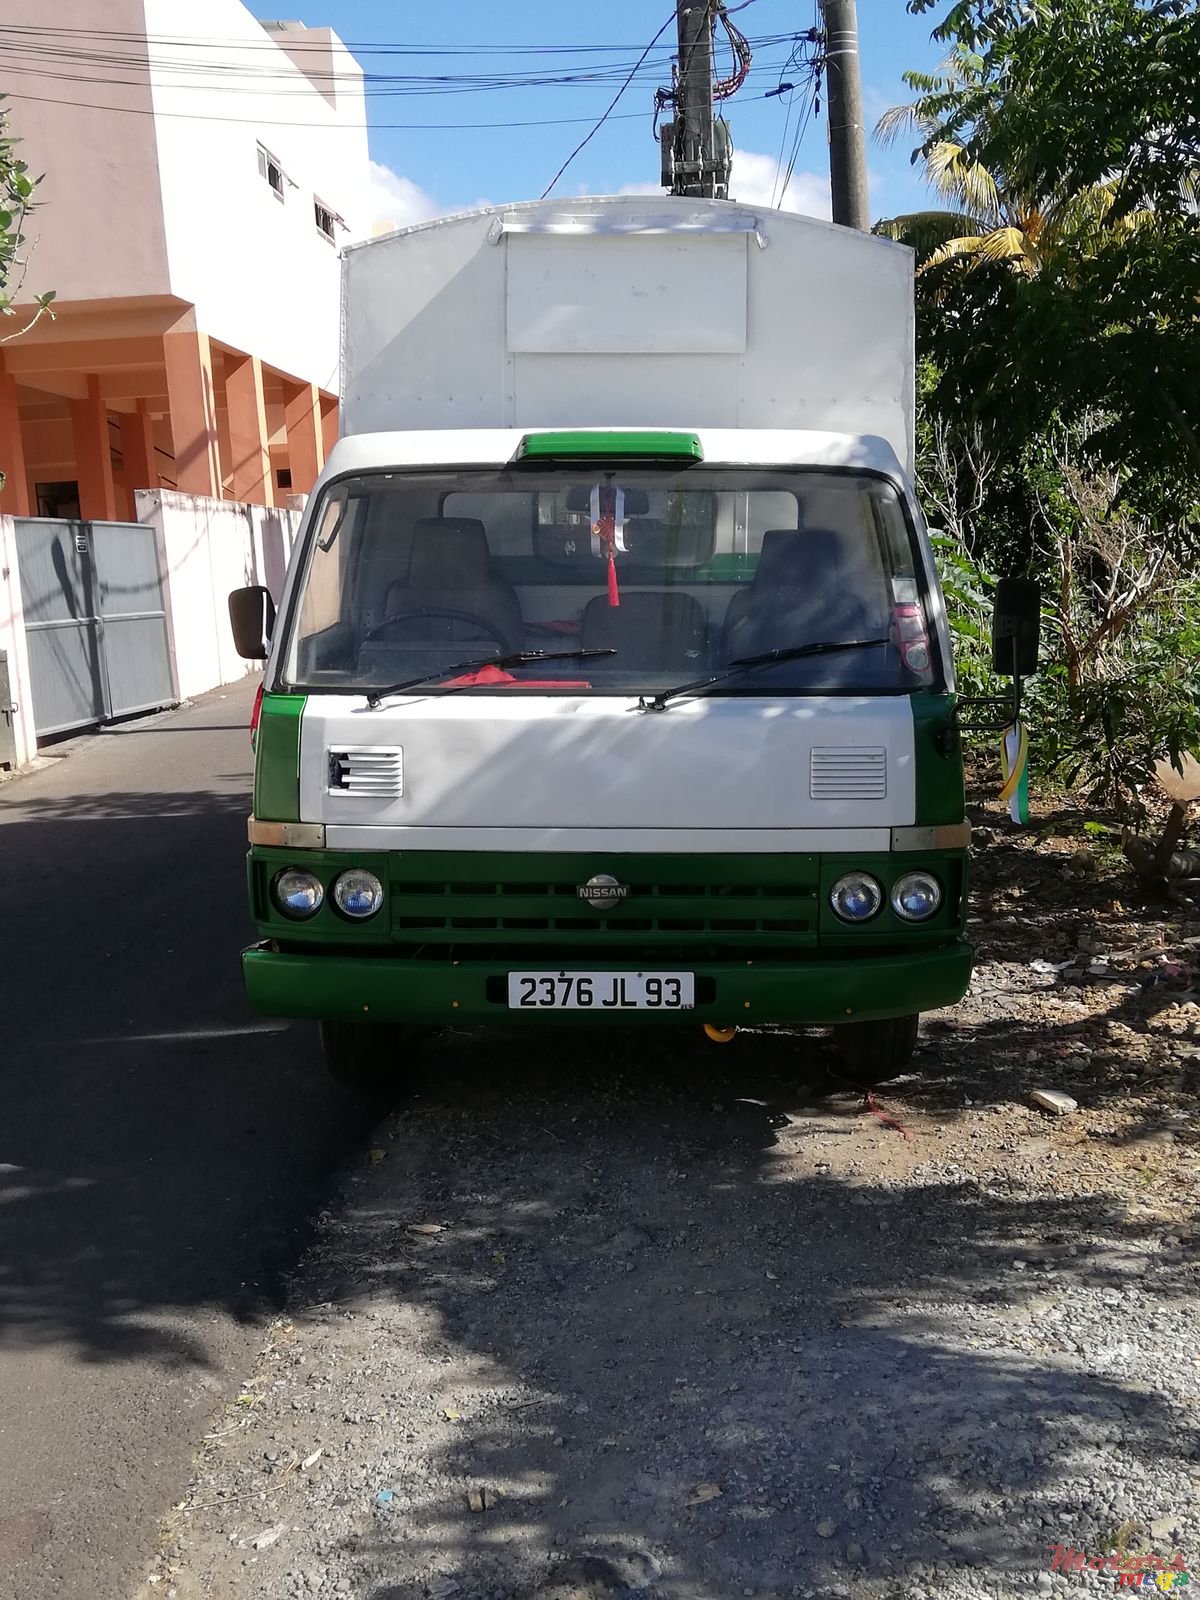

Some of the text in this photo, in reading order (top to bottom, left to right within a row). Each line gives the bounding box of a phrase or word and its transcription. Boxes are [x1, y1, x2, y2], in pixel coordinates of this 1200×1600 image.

[579, 887, 627, 898] NISSAN
[520, 978, 681, 1007] 2376 JL 93
